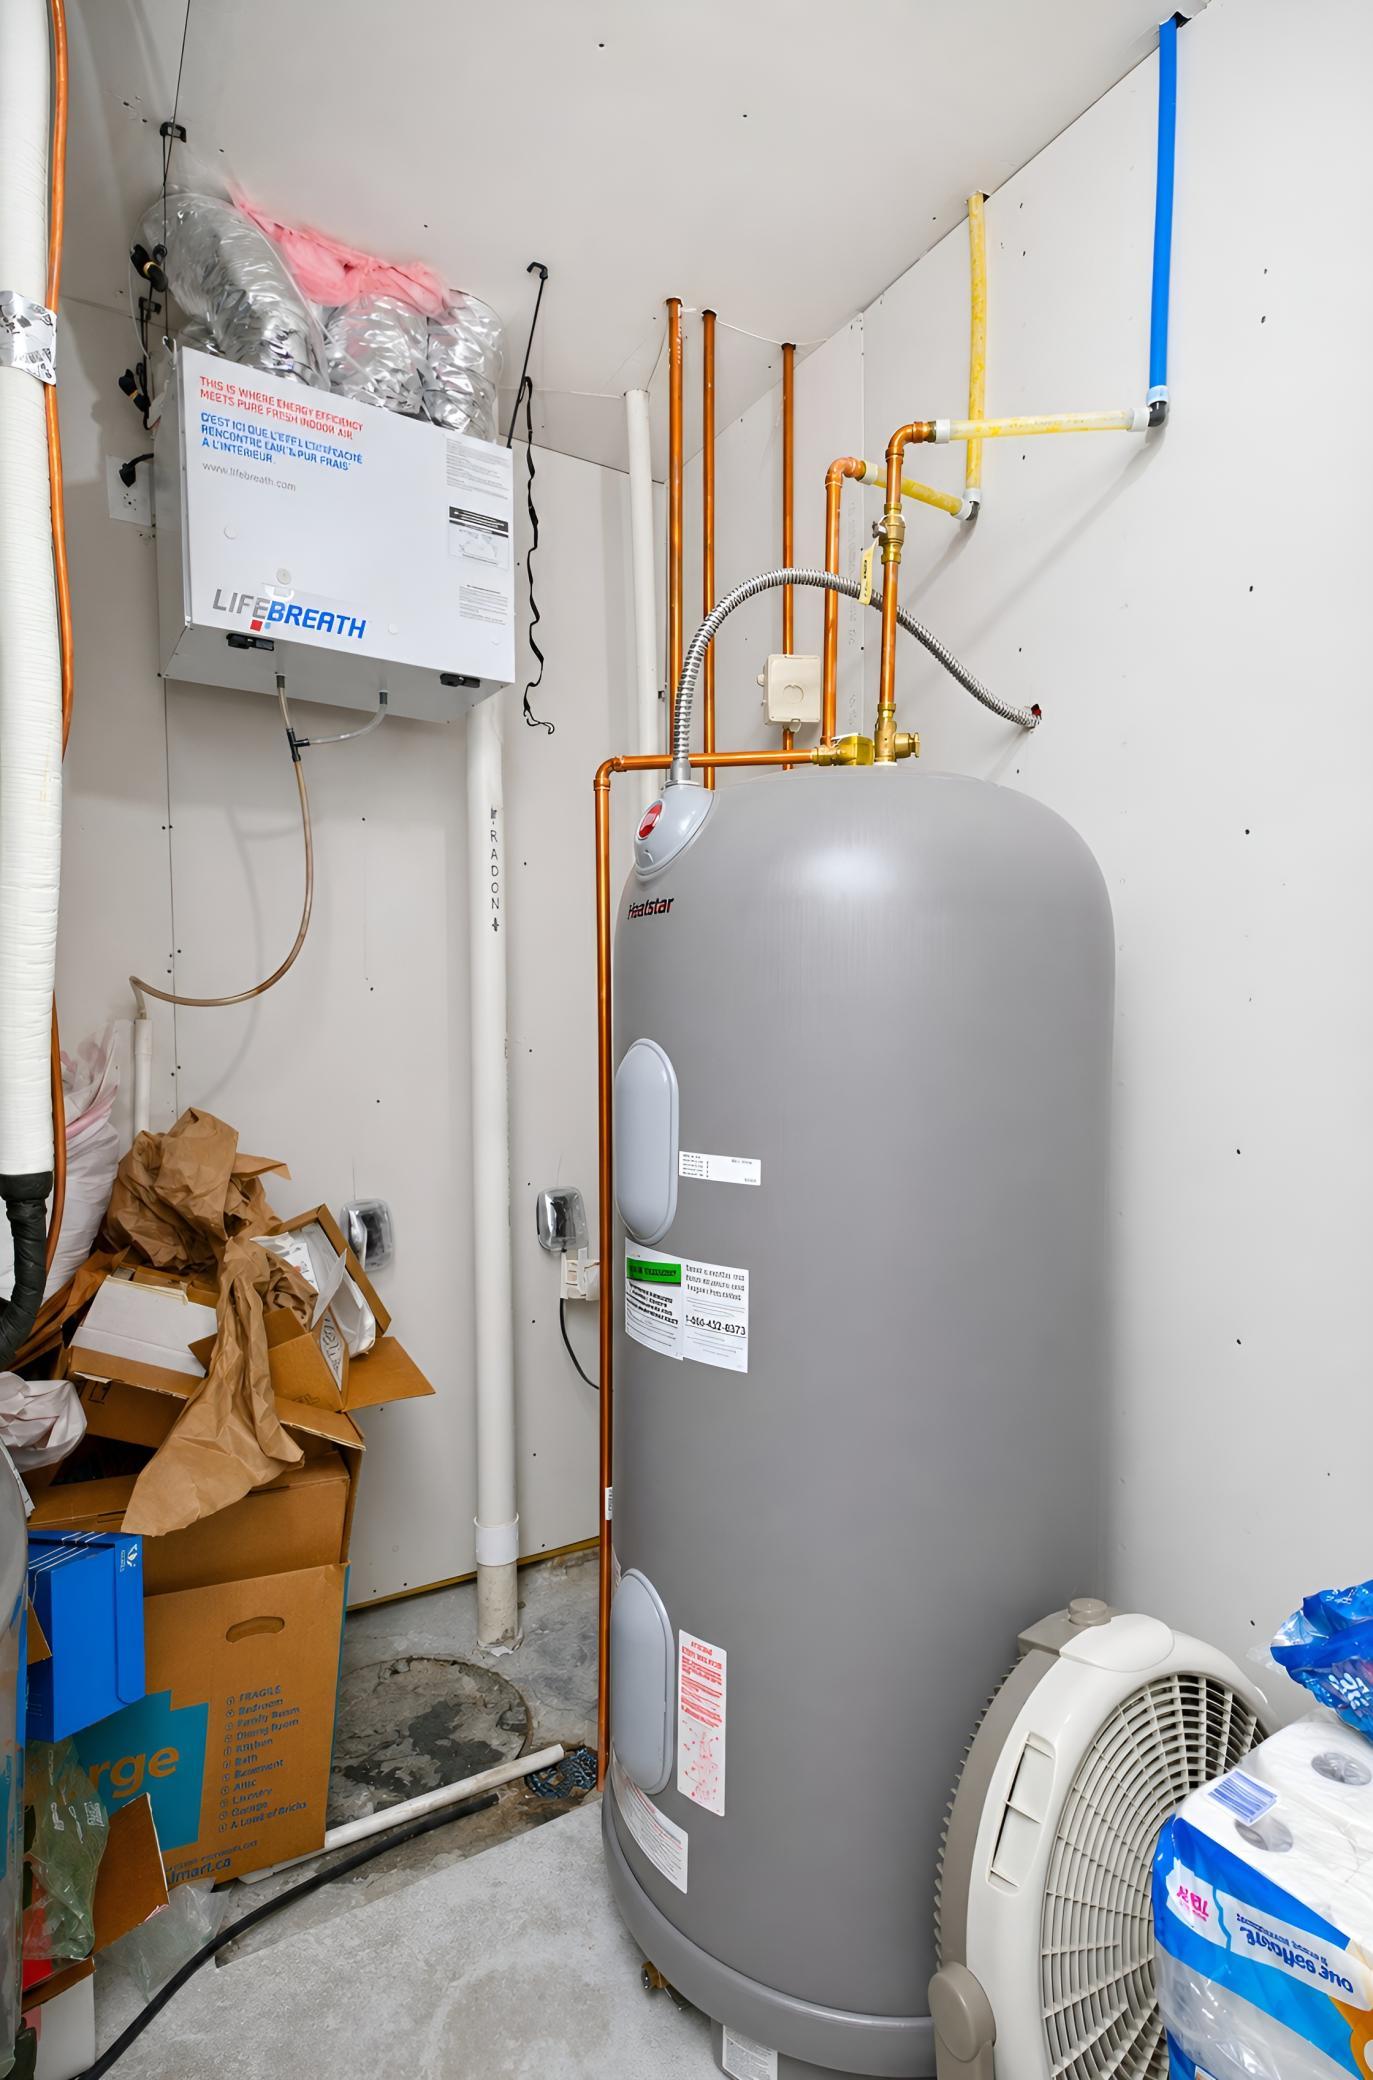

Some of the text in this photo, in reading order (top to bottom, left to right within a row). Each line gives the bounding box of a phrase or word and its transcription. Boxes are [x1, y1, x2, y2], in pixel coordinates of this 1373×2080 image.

[200, 375, 363, 432] THIS IS WHERE ENERGY EFFICIENCY
[200, 388, 235, 407] MEETS
[237, 398, 264, 415] PURE
[266, 406, 298, 423] FRESH
[300, 417, 335, 434] INDOOR
[201, 412, 230, 428] C'EST
[232, 420, 245, 432] ICI
[247, 424, 268, 439] QUE
[201, 424, 262, 449] RENCONTRE
[297, 450, 317, 463] PUR
[202, 461, 296, 492] www.lifebreath.com
[490, 829, 500, 910] RADON
